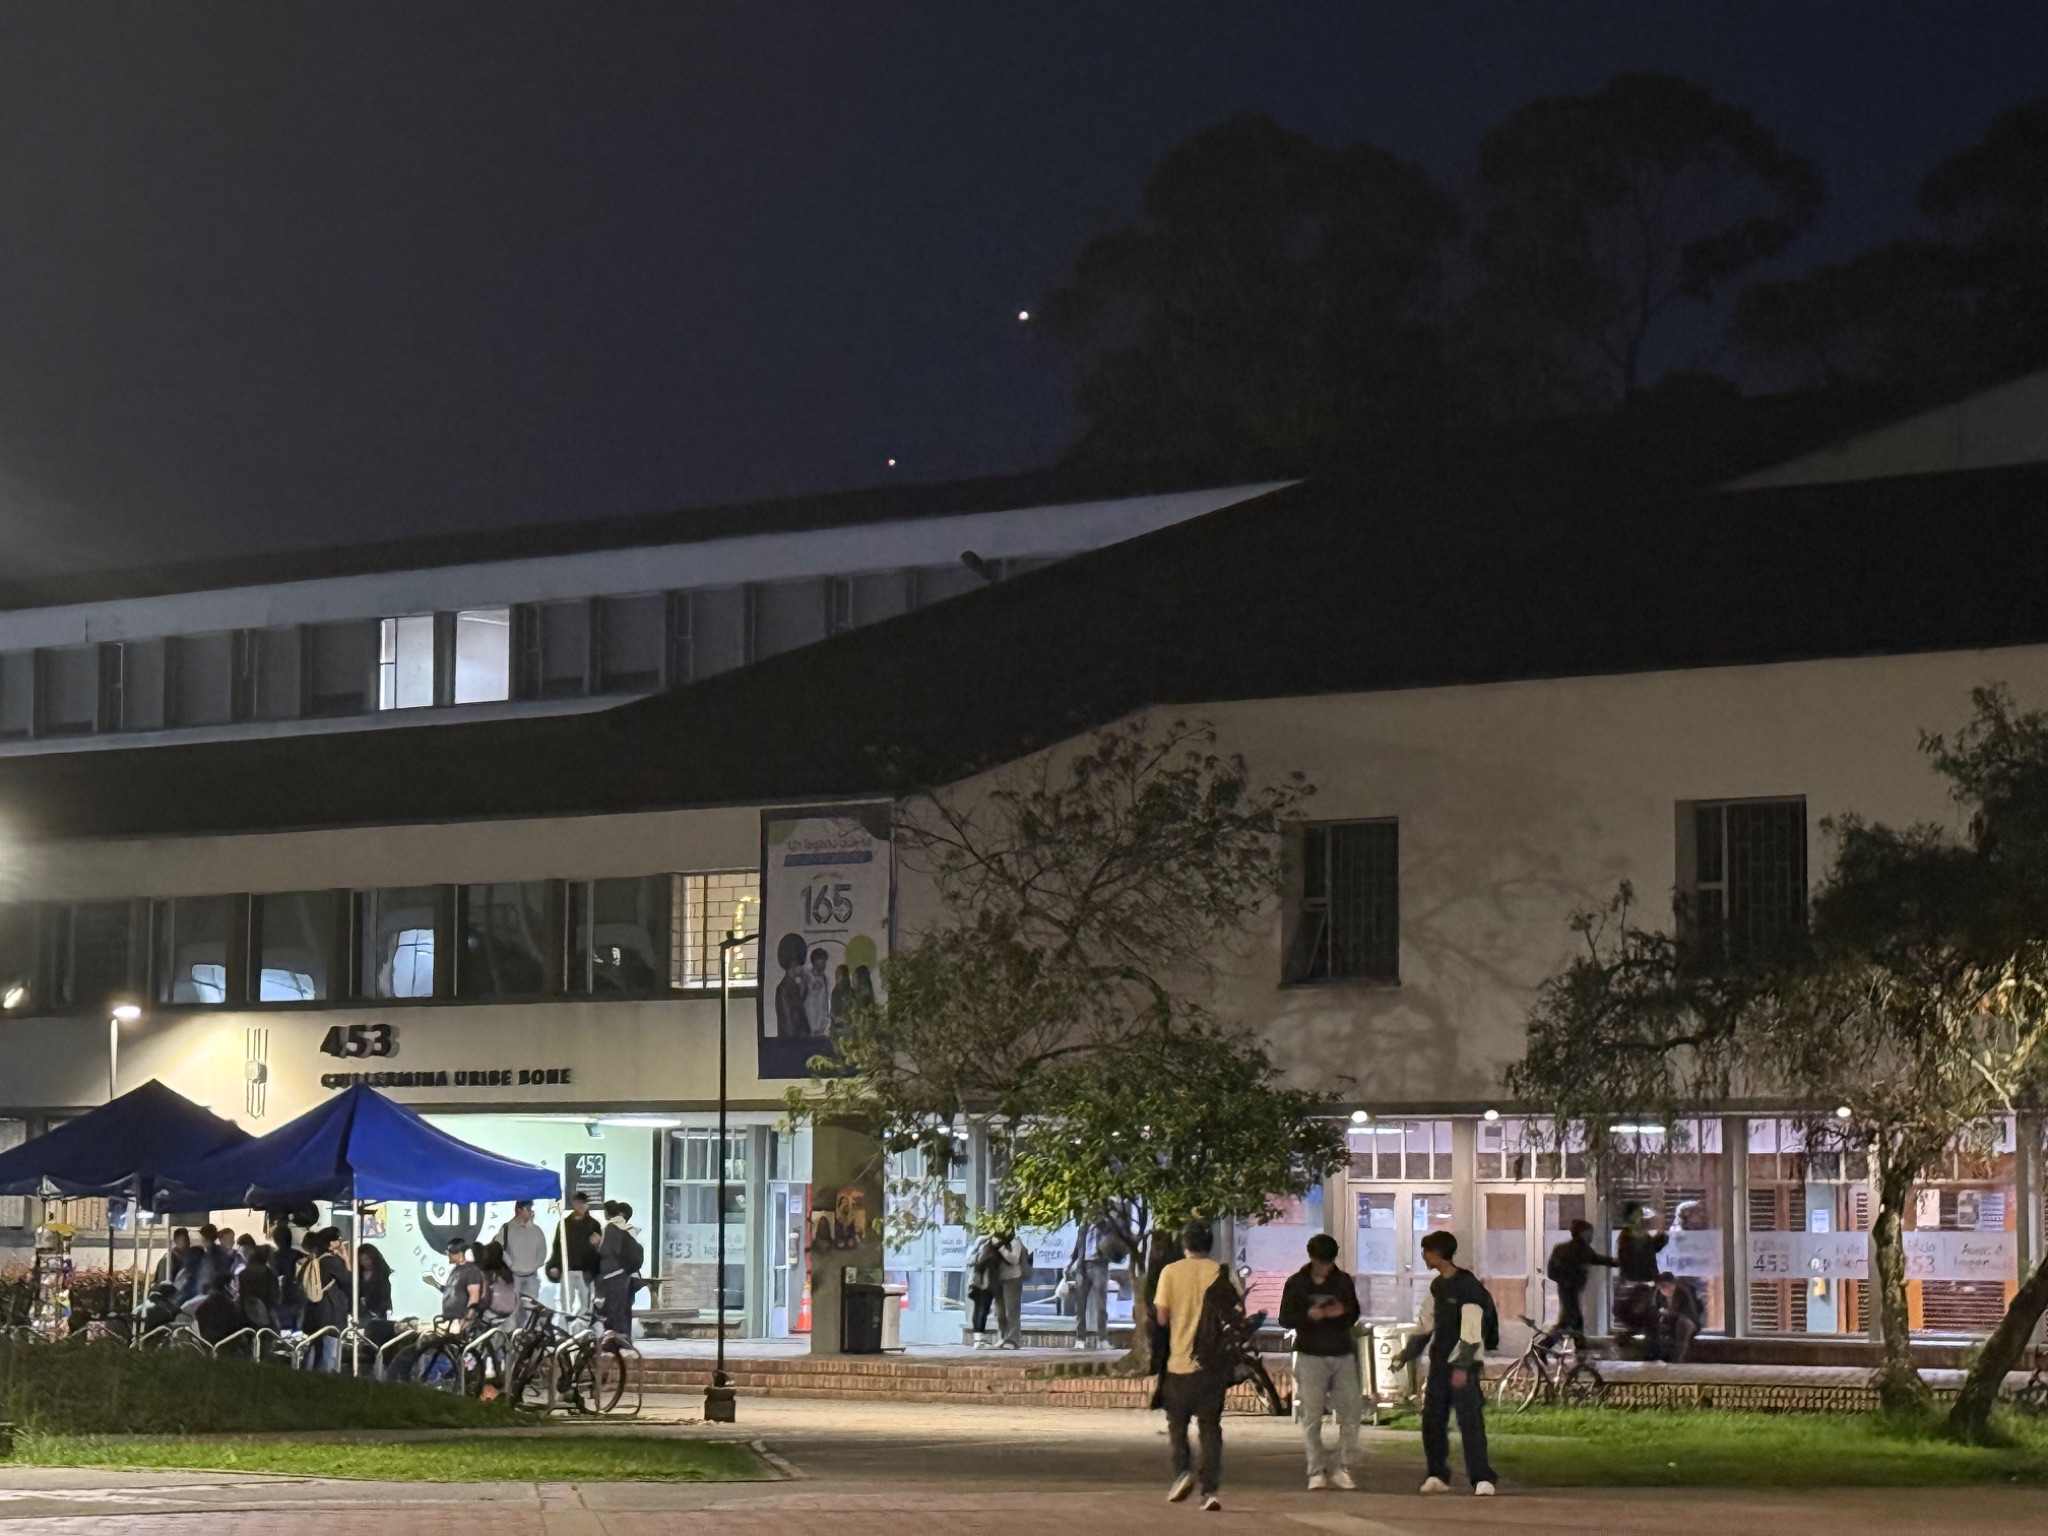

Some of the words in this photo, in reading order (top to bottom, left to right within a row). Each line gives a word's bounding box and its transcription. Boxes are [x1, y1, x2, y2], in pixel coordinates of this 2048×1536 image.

[800, 884, 853, 925] 165
[320, 1024, 393, 1058] 453
[454, 1070, 512, 1087] URIBE
[518, 1068, 571, 1085] BONE
[576, 1155, 604, 1175] 453
[1753, 1254, 1789, 1272] 453
[1905, 1255, 1936, 1274] 53
